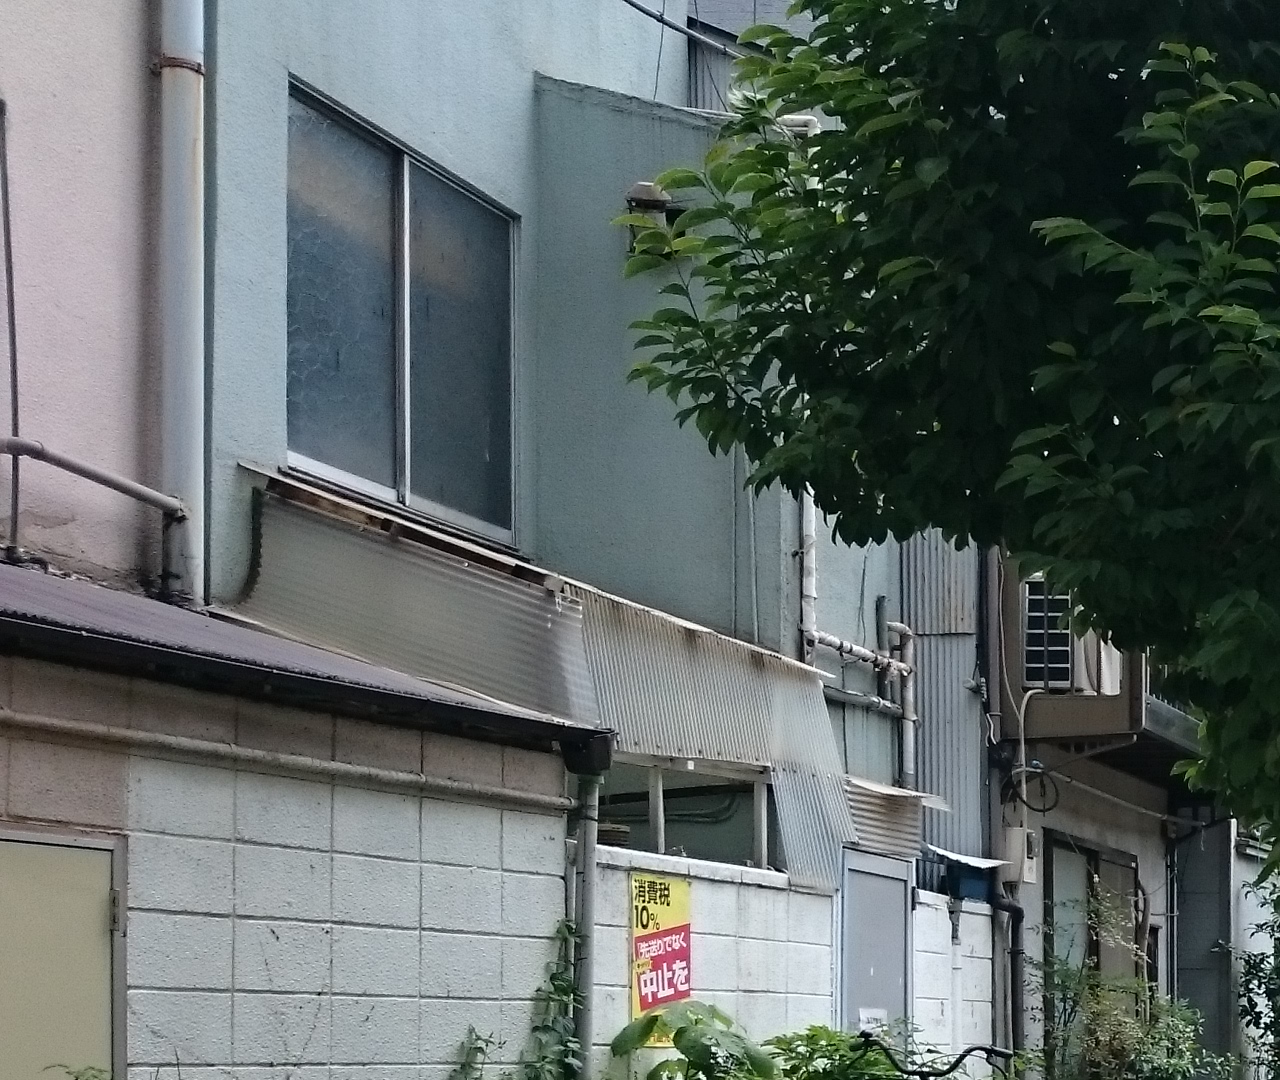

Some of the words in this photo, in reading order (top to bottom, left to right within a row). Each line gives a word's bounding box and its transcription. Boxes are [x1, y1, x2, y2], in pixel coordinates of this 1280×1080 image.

[634, 879, 670, 906] 消費税
[634, 905, 660, 930] 10%
[640, 960, 688, 1002] 中止を
